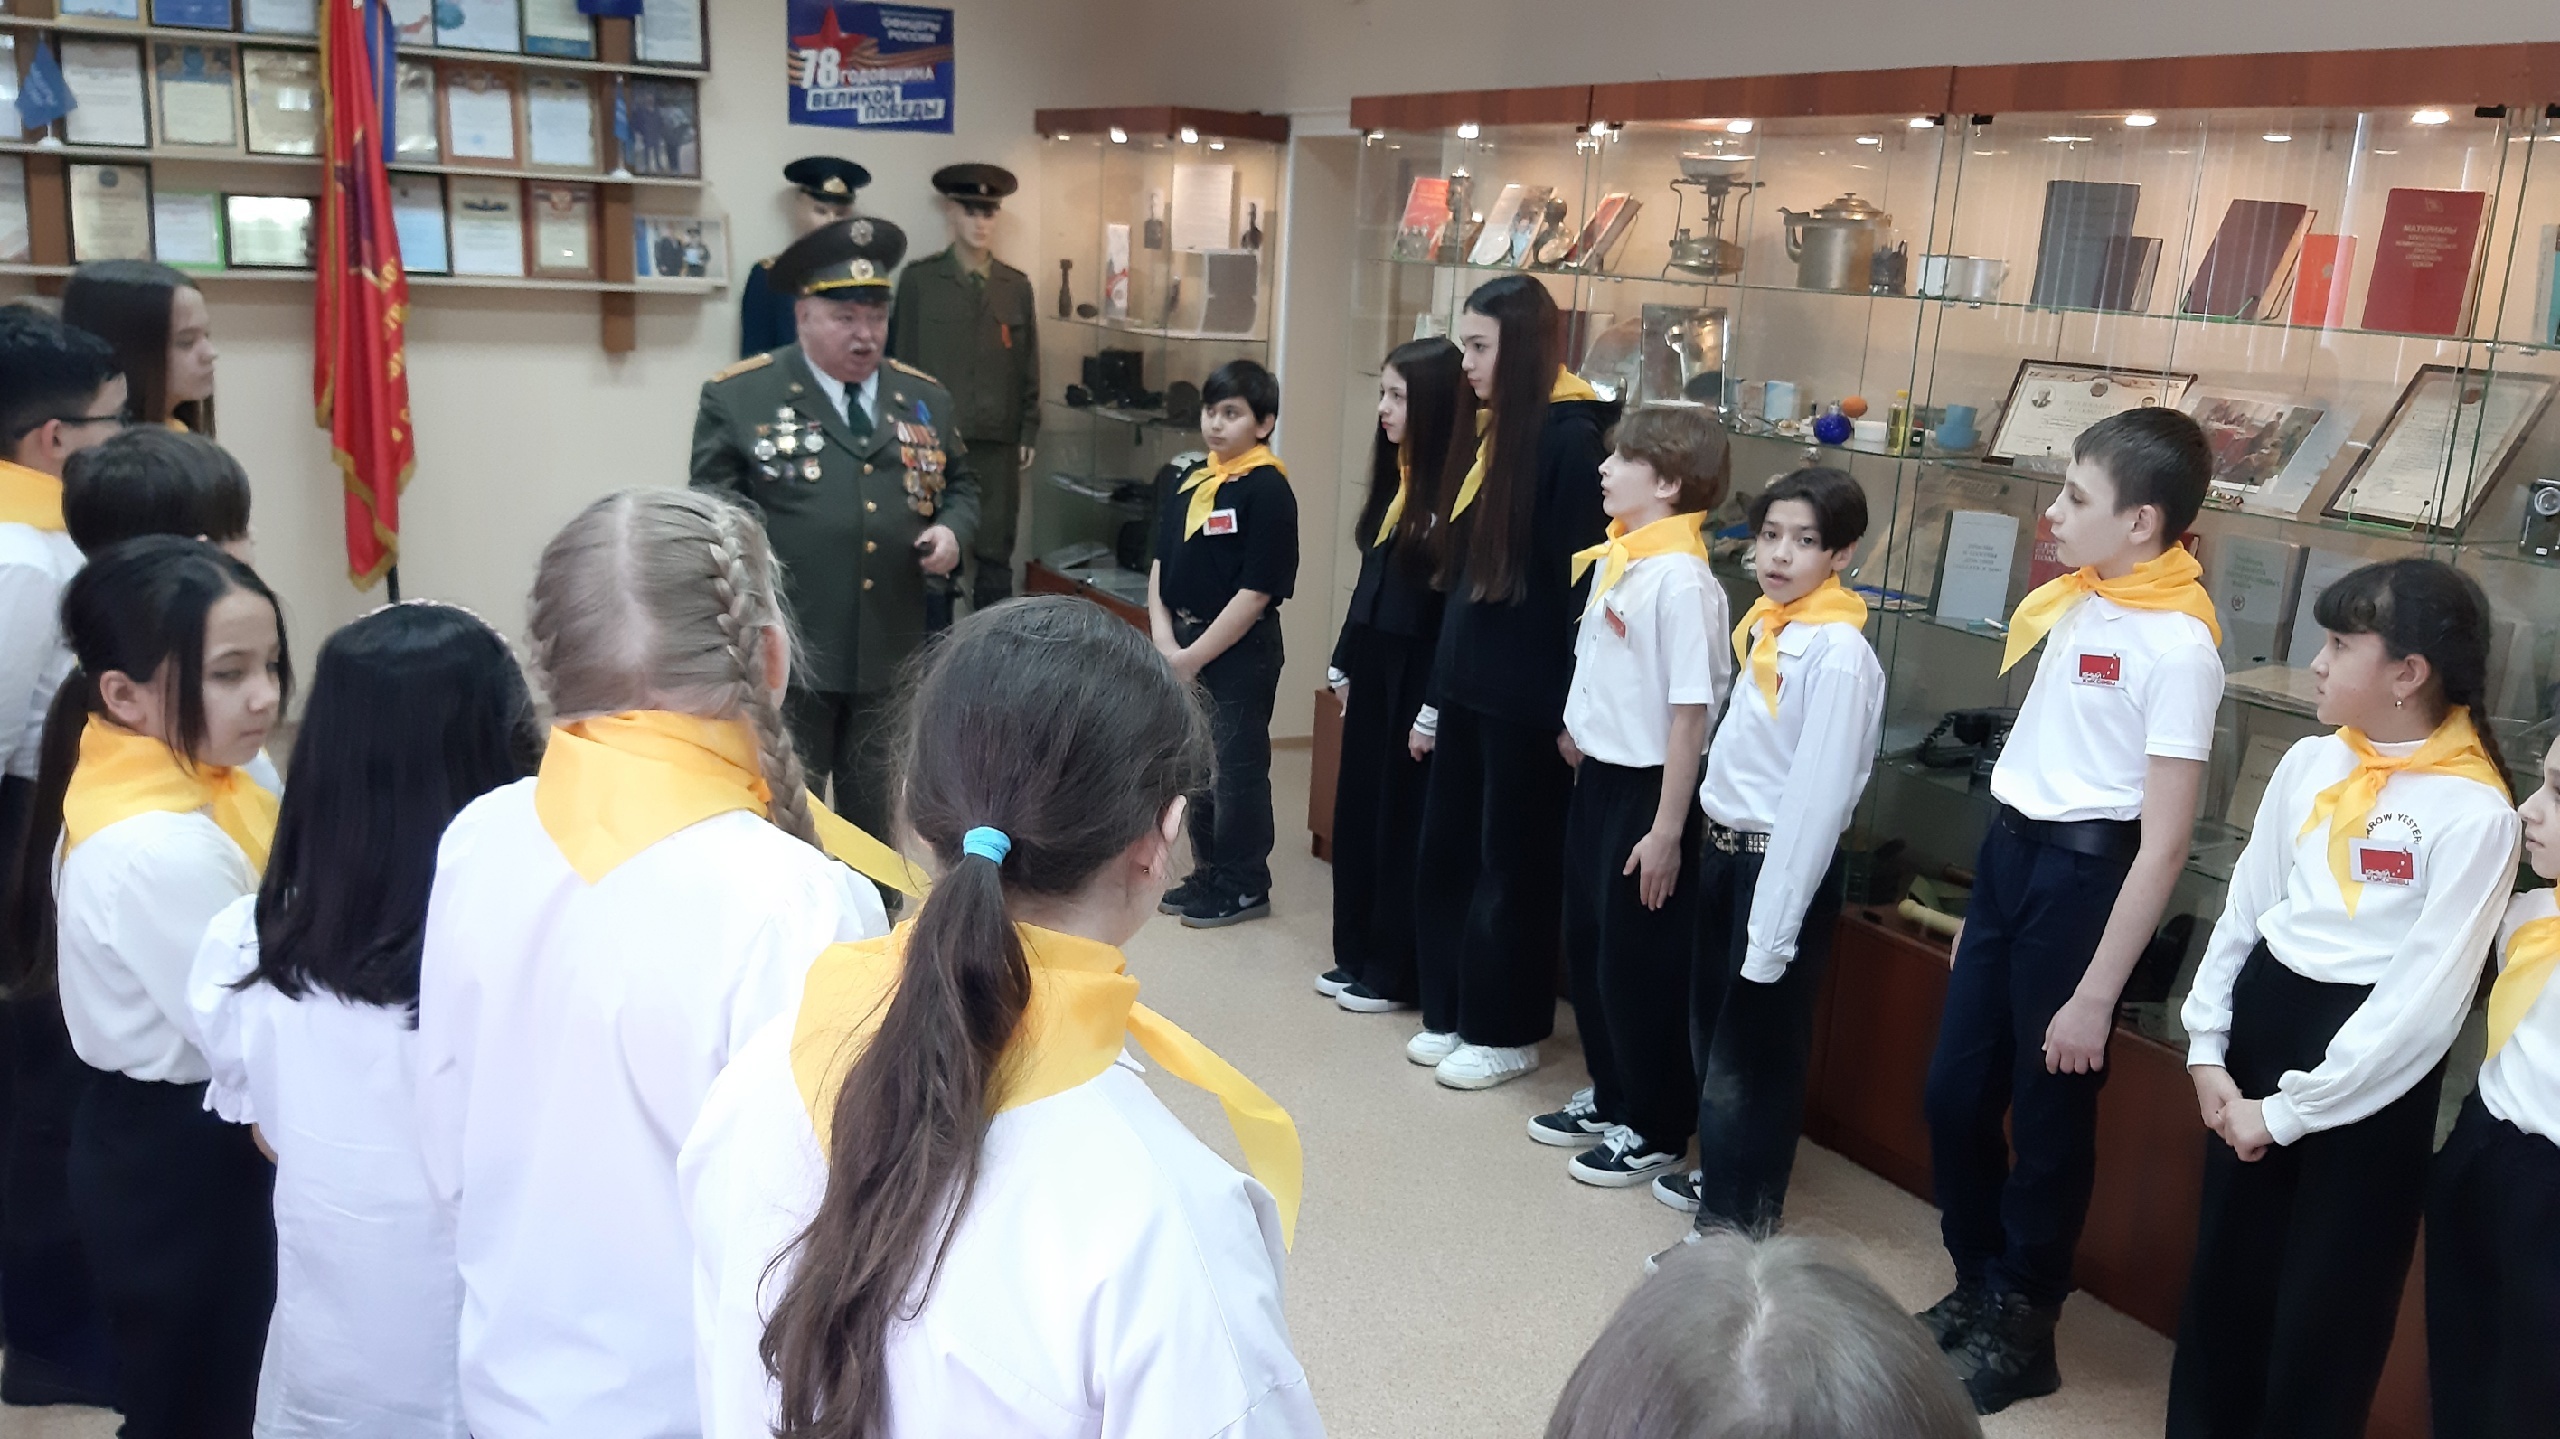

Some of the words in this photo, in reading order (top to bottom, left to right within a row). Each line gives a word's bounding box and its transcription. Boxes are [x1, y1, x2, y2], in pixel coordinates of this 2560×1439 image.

[799, 47, 841, 89] 78
[841, 65, 935, 86] ГОДОВЩИНА
[812, 88, 896, 108] ВЕЛИКОЙ
[865, 101, 938, 120] ПОБЕДЫ
[2404, 224, 2458, 235] МАТЕРИАЛЫ
